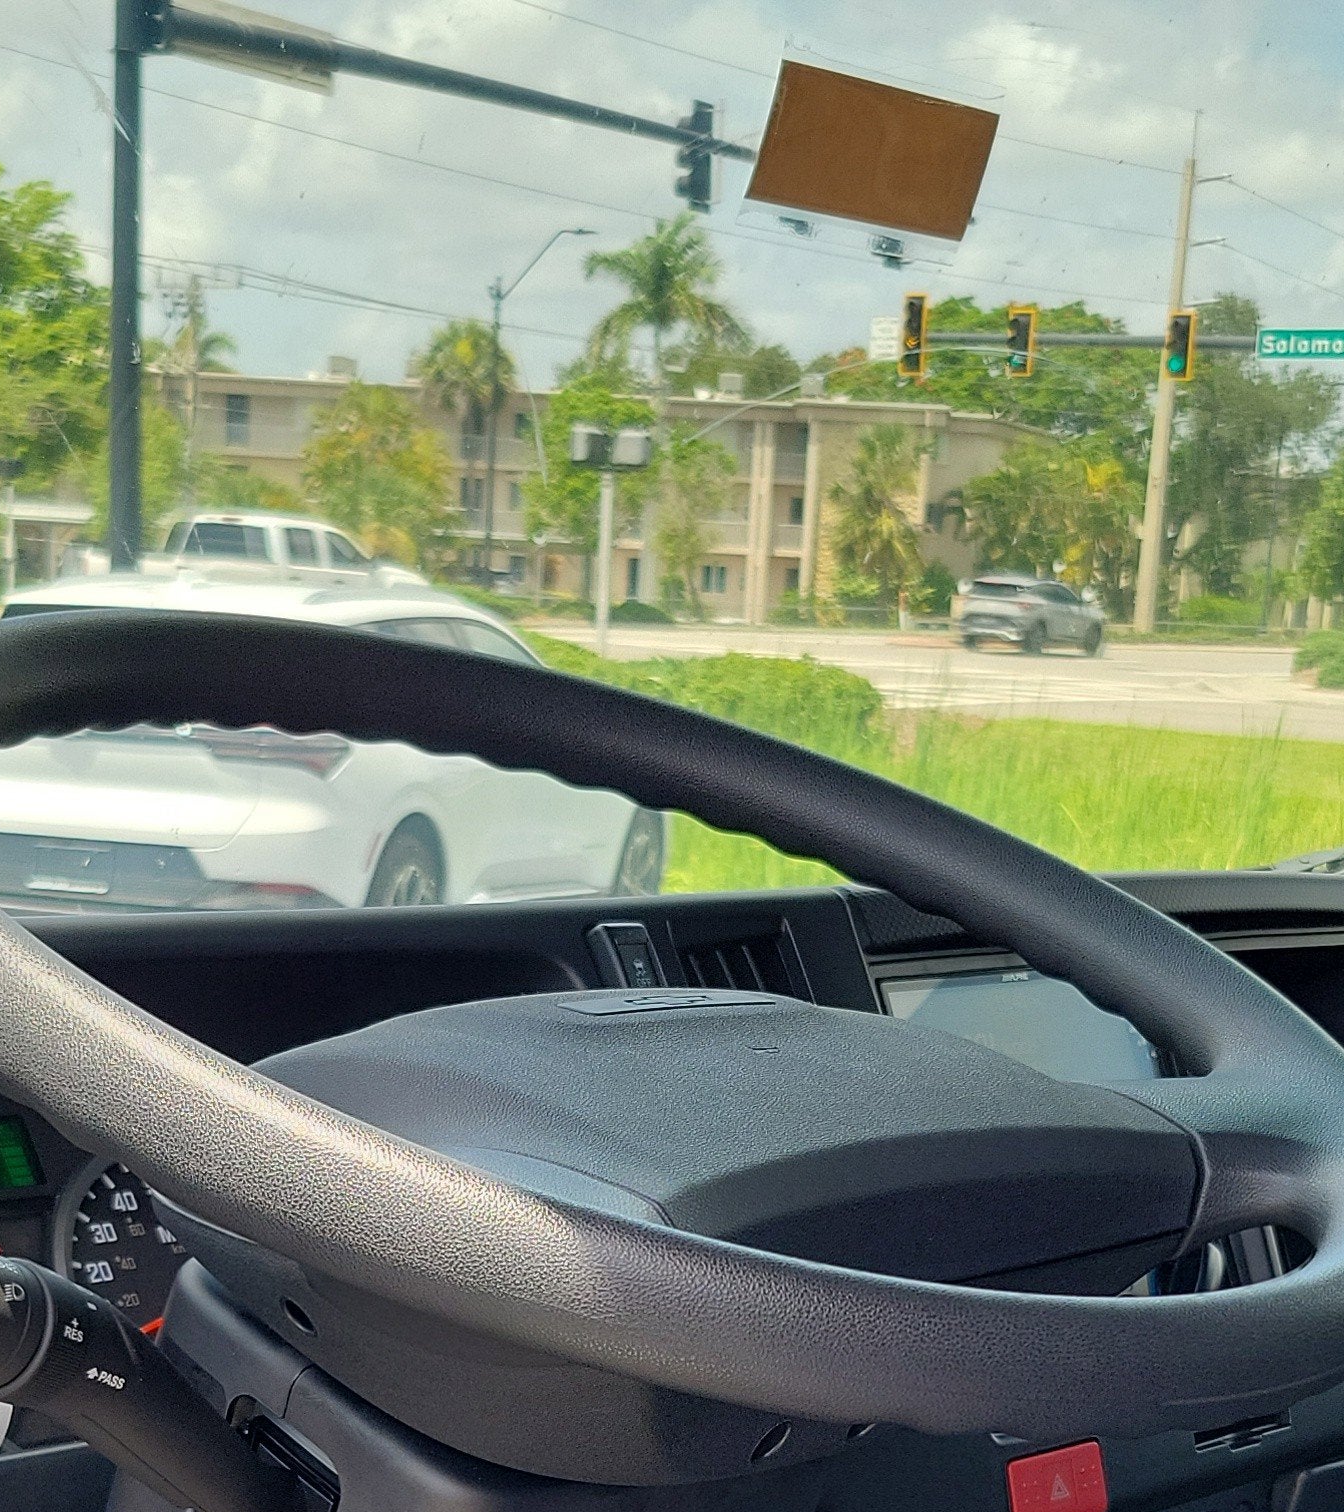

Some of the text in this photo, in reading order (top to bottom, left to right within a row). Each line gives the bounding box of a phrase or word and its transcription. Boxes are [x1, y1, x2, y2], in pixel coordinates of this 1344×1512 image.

[114, 1191, 138, 1212] 40
[90, 1223, 118, 1244] 30
[86, 1261, 114, 1284] 20
[121, 1257, 137, 1270] 40
[123, 1293, 140, 1307] 20
[64, 1325, 84, 1342] RES
[98, 1370, 126, 1390] PASS
